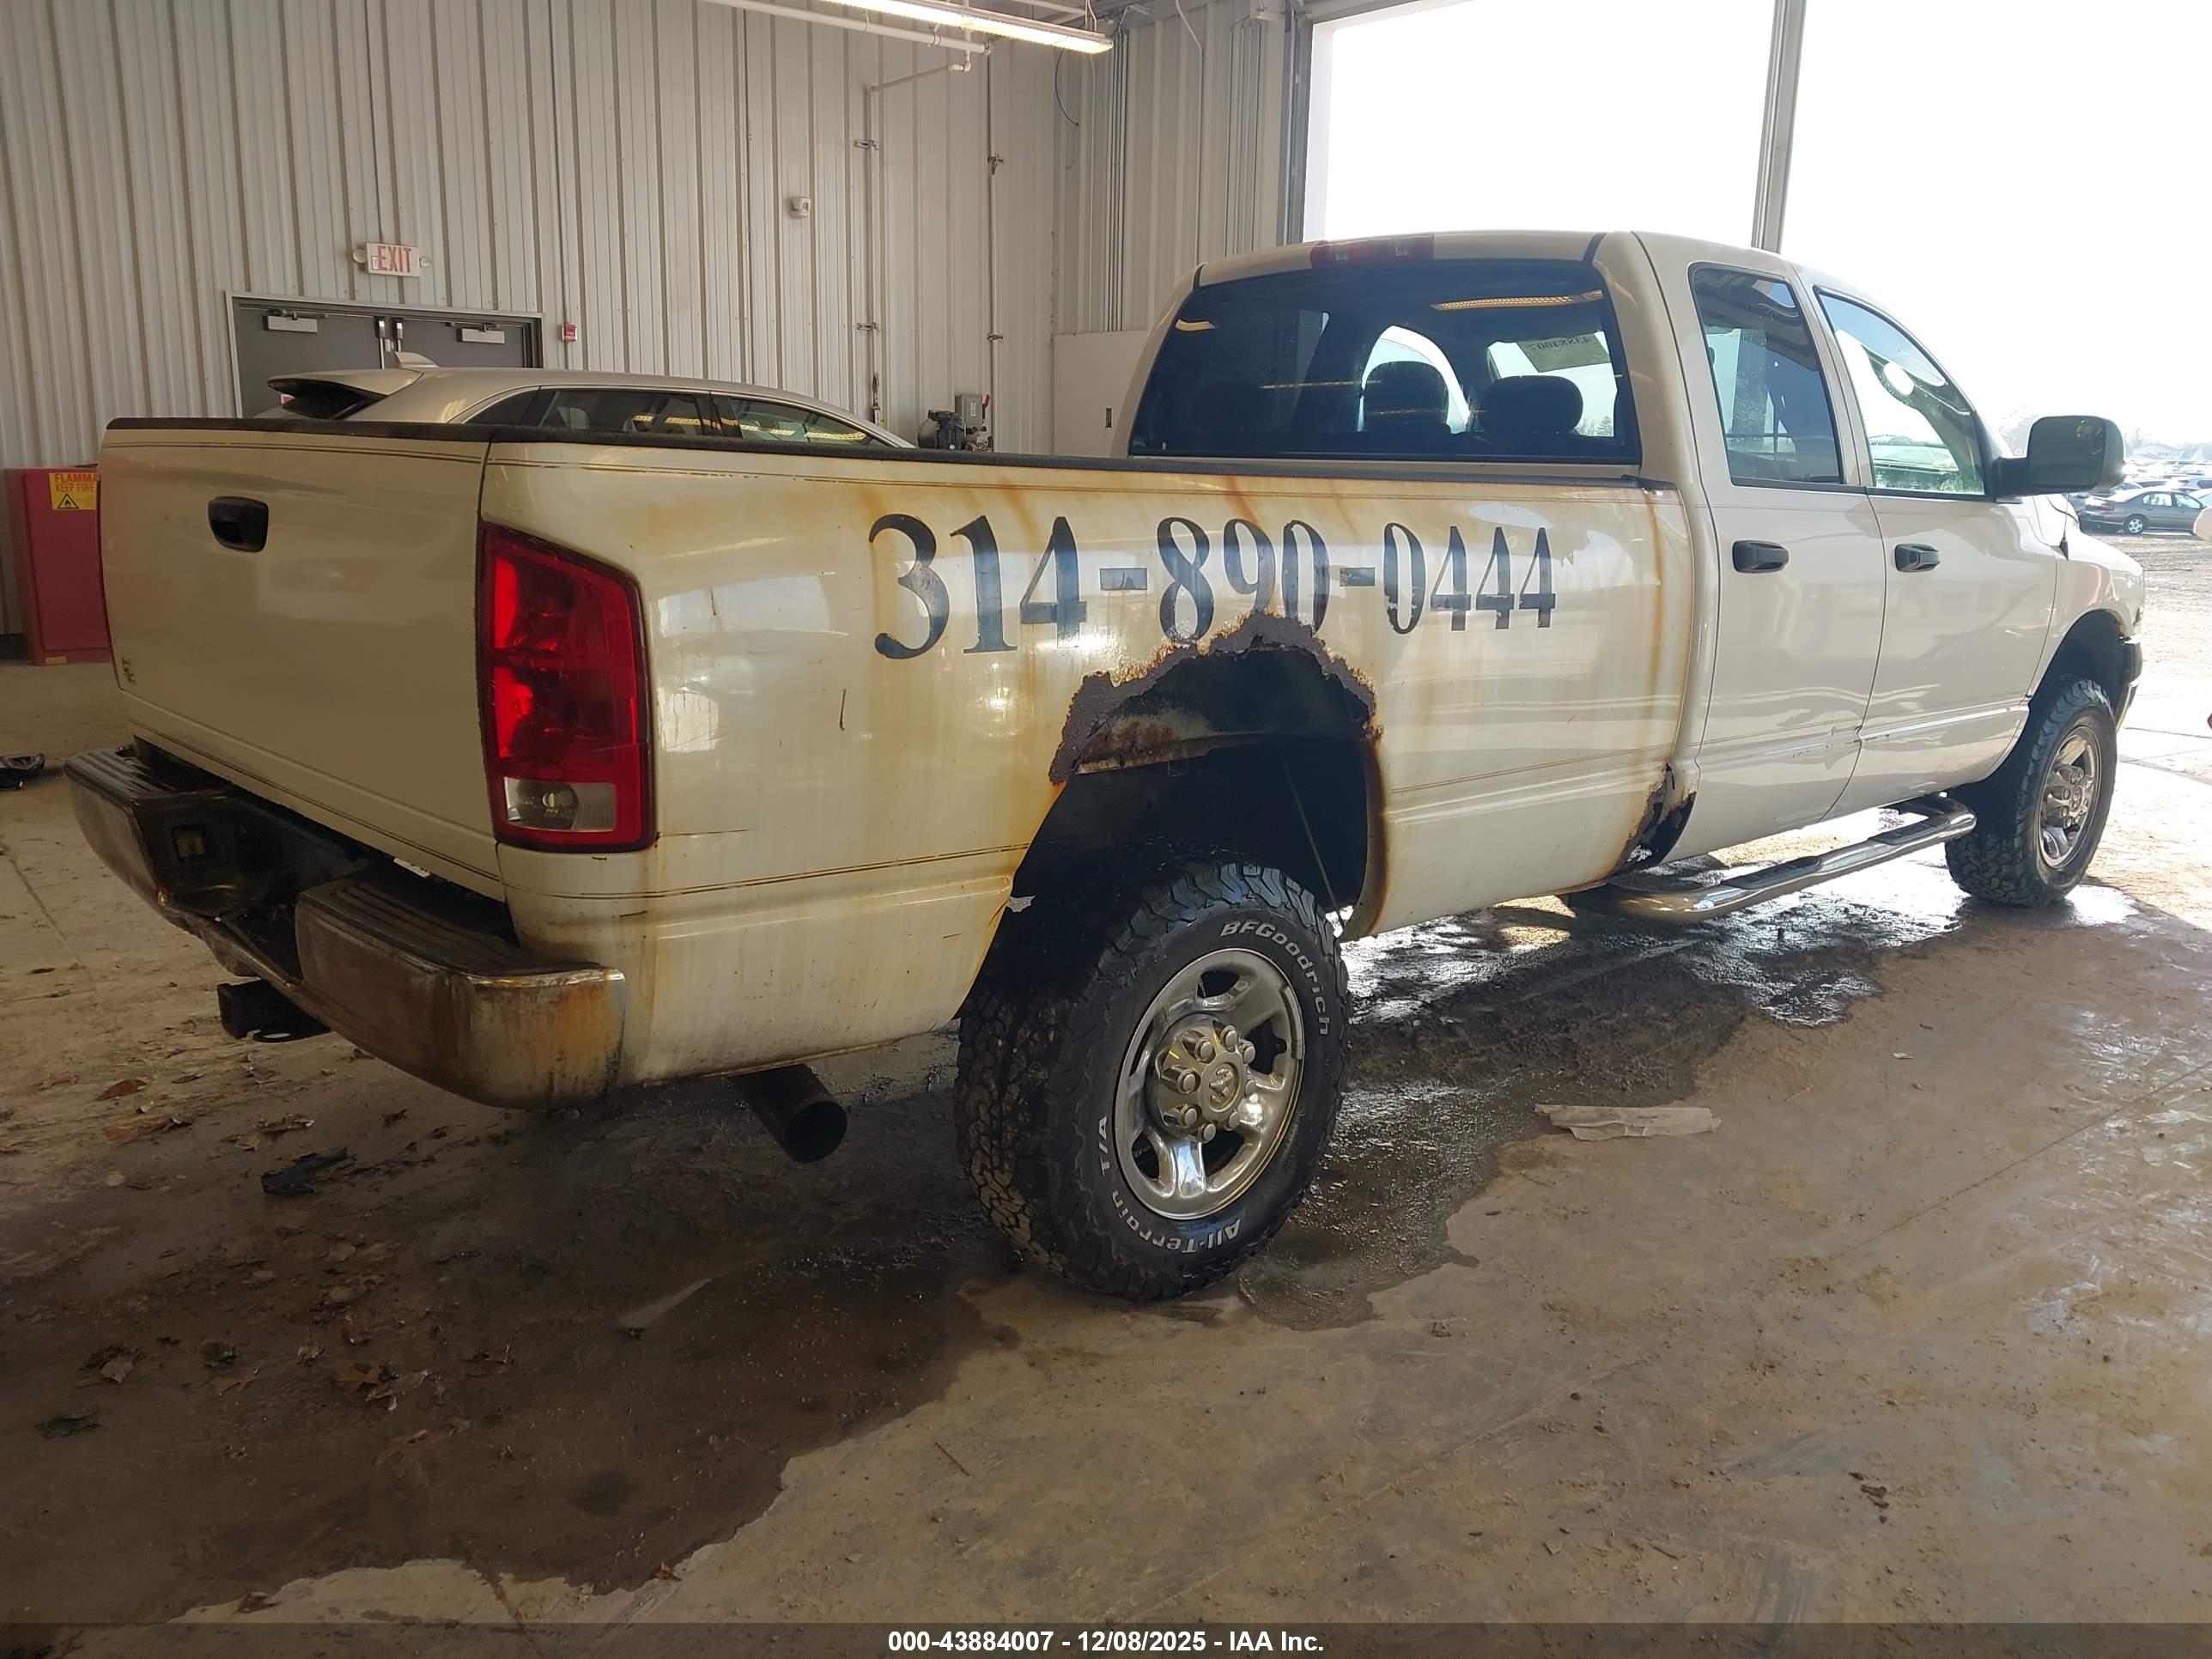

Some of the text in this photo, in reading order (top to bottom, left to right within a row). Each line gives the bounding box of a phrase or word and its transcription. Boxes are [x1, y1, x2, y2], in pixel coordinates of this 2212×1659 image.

[377, 246, 411, 272] EXIT
[868, 514, 1557, 659] 314-890-0444
[1220, 920, 1330, 1036] BFGoodrich
[1098, 1115, 1242, 1254] All-Terrain T/A
